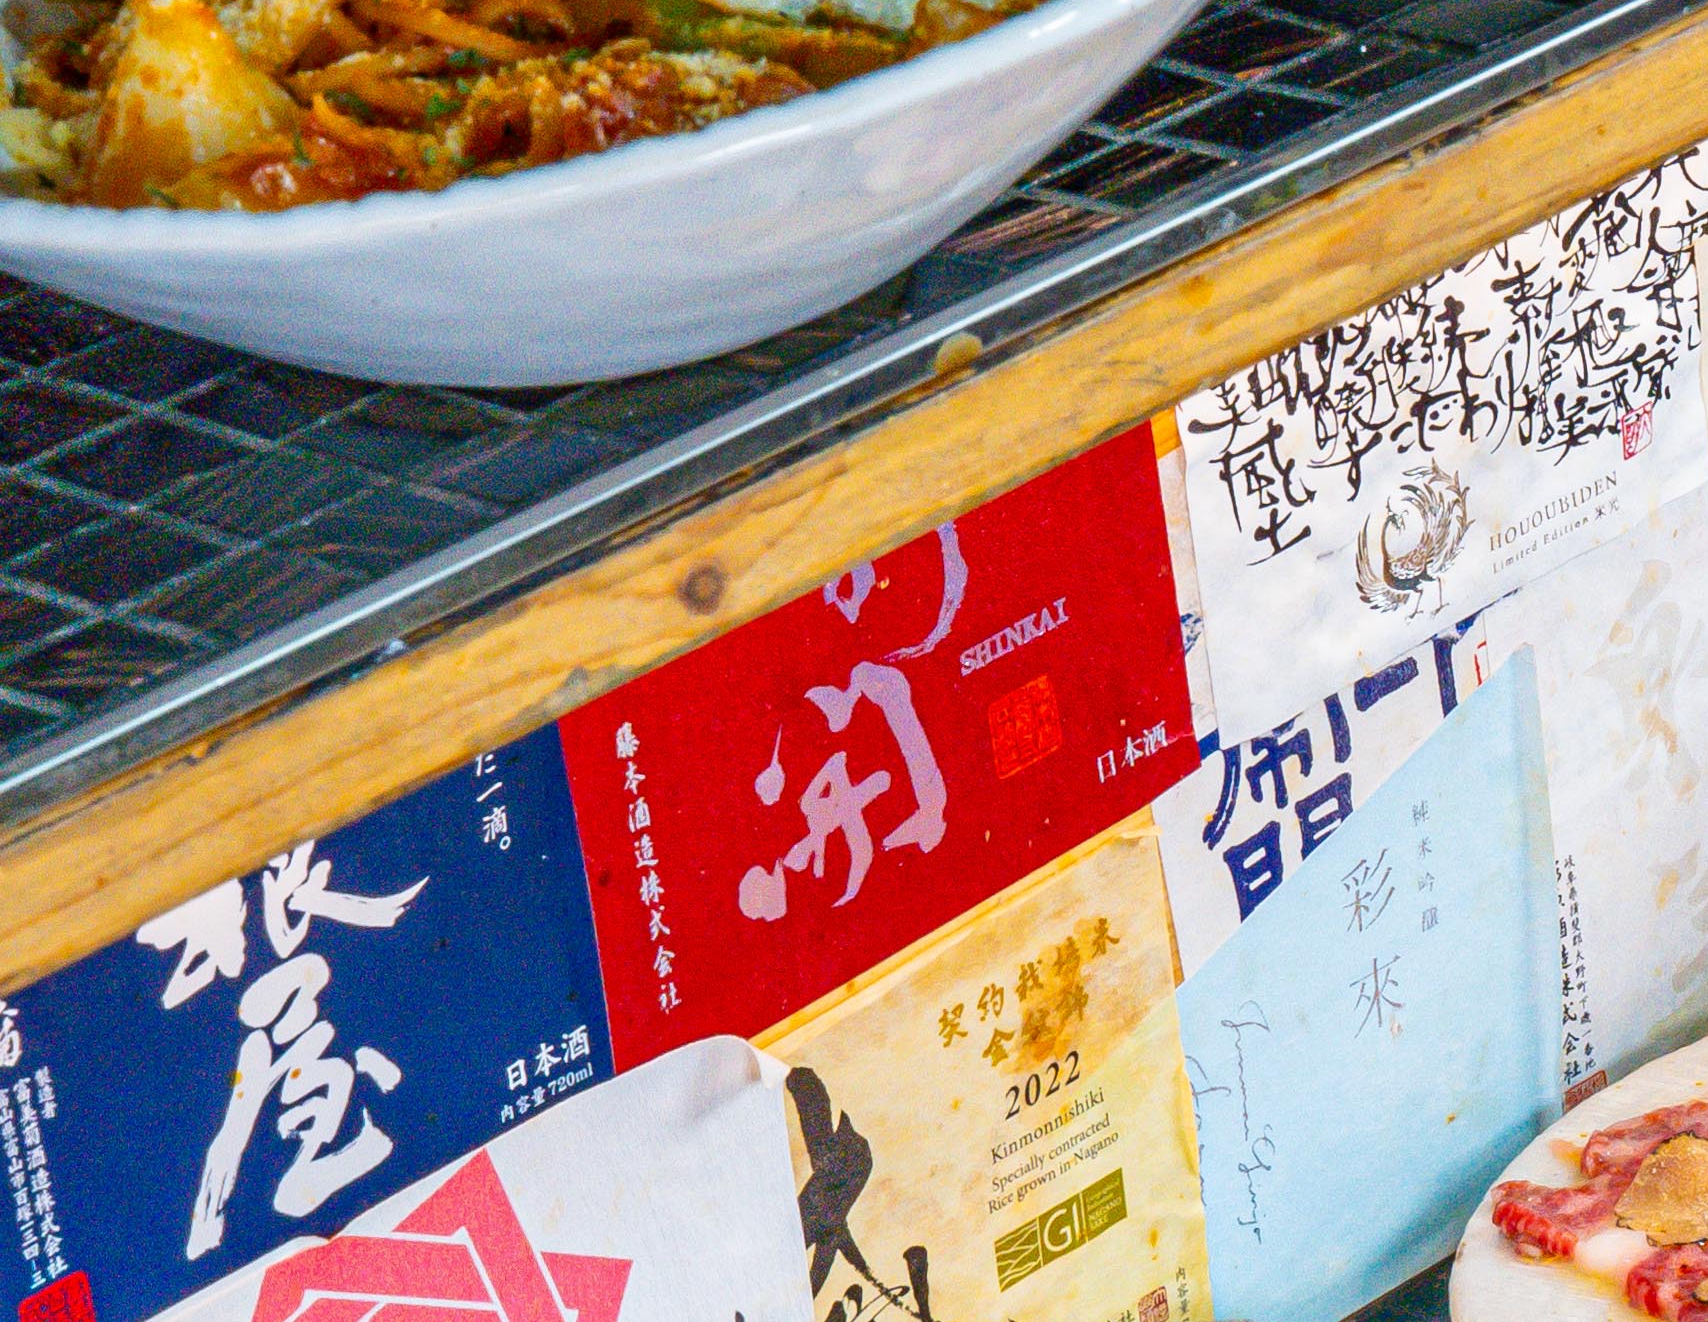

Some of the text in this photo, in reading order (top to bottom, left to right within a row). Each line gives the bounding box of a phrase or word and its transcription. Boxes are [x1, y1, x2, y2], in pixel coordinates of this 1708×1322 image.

[1489, 469, 1618, 553] HOUOUBIDEN
[1492, 539, 1538, 575] Limited
[1543, 516, 1589, 546] Edition
[960, 597, 1070, 677] SHINKAI
[1095, 719, 1169, 785] 日本酒
[505, 1023, 592, 1093] 日本酒
[1004, 1050, 1081, 1121] 2022
[991, 1086, 1105, 1166] Kinmonnishiki
[991, 1149, 1046, 1193] Specially
[1048, 1112, 1111, 1161] contracted
[988, 1192, 1014, 1215] Rice
[1016, 1169, 1057, 1203] grown
[1059, 1158, 1072, 1175] in
[1073, 1131, 1120, 1163] Nagano
[1042, 1199, 1081, 1253] GI
